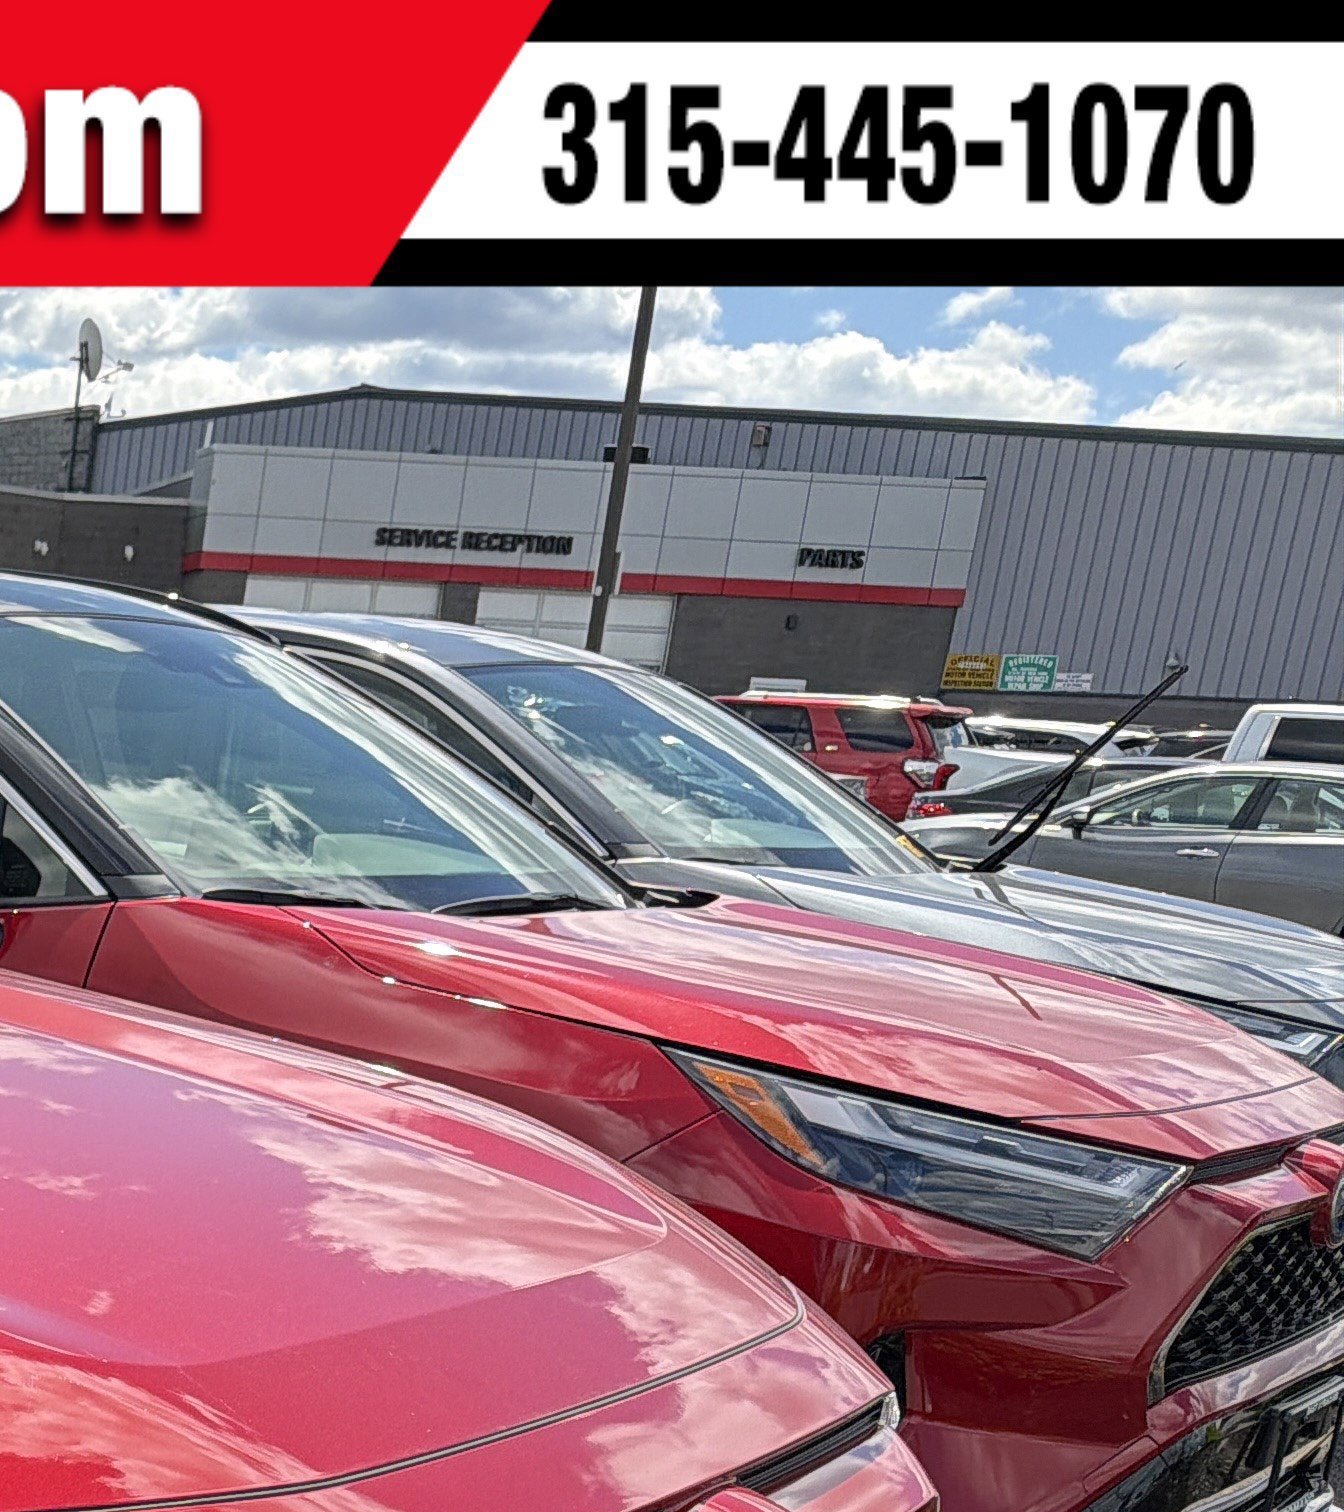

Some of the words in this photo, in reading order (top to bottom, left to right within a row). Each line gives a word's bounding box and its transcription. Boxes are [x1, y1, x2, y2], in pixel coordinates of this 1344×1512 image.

[375, 527, 459, 549] SERVICE
[461, 531, 574, 555] RECEPTION
[798, 547, 865, 570] PARTS
